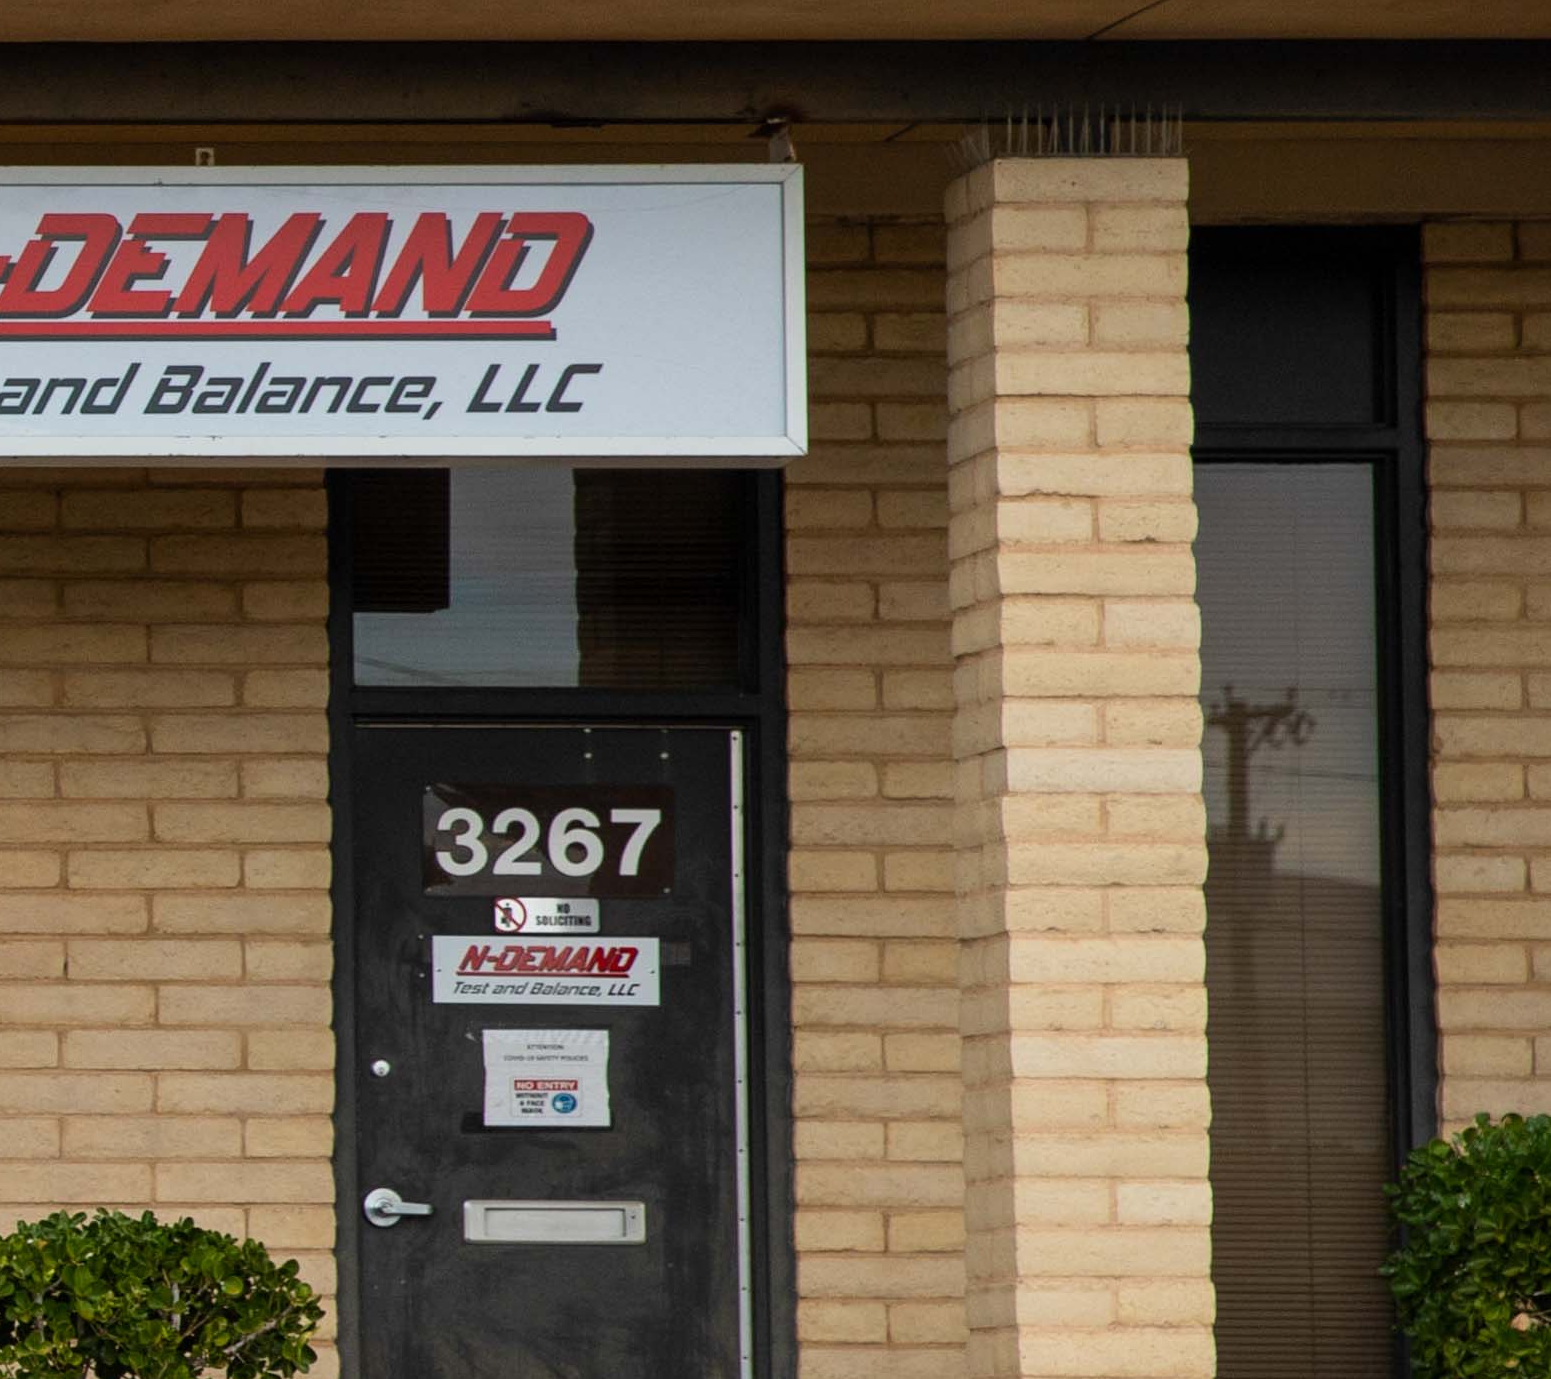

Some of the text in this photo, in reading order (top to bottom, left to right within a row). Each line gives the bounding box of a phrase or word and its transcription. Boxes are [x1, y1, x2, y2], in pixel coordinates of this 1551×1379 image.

[143, 362, 442, 420] Balance,
[466, 364, 603, 413] LLC
[437, 808, 661, 876] 3267
[557, 903, 571, 914] NO
[536, 915, 592, 927] SOLICITING
[459, 945, 639, 973] N-DEMAND
[453, 981, 641, 997] Test and Balance, LLC
